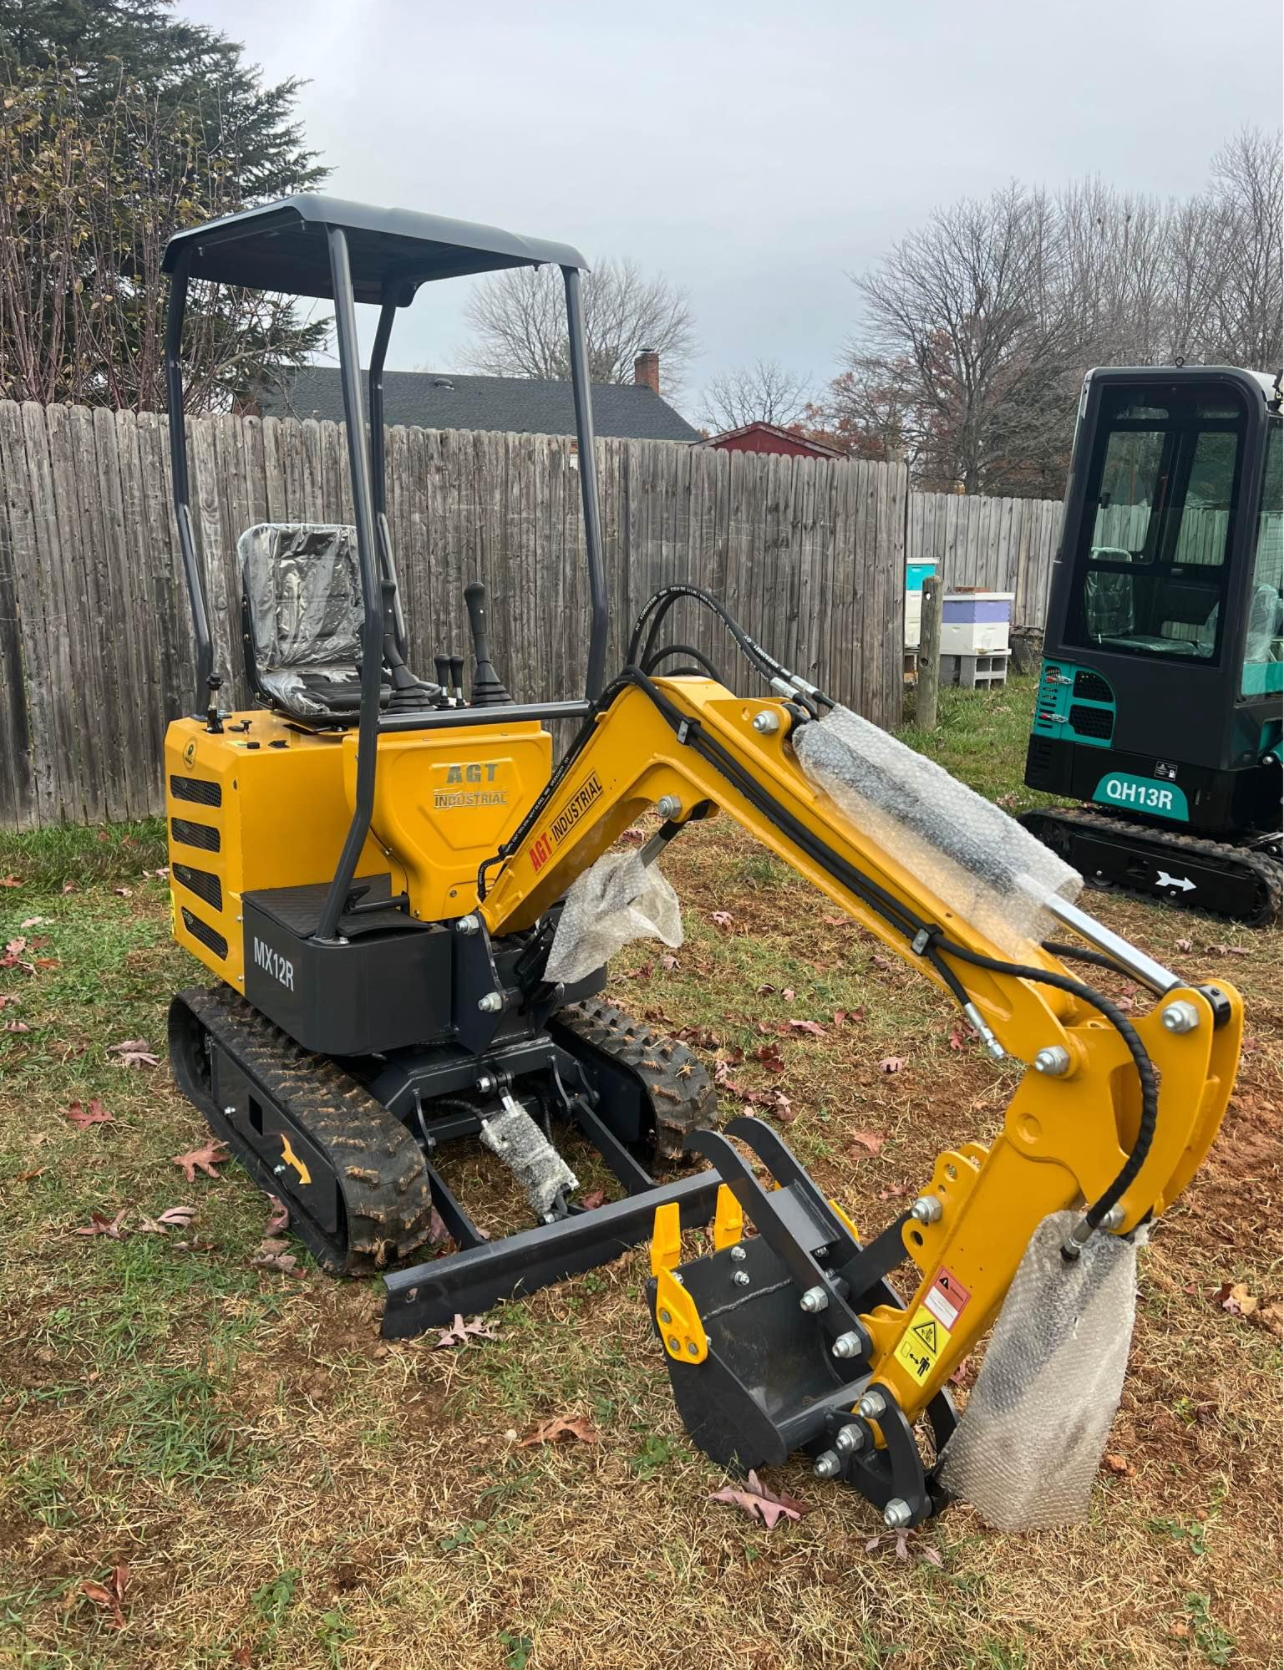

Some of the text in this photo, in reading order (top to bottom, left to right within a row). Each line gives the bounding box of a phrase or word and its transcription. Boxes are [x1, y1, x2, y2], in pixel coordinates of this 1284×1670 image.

[446, 763, 499, 784] AGT
[434, 792, 508, 807] INDUSTRIAL
[1107, 780, 1173, 810] QH13R
[529, 832, 553, 872] AGT
[551, 777, 603, 842] INDUSTRIAL
[254, 936, 294, 992] MX12R
